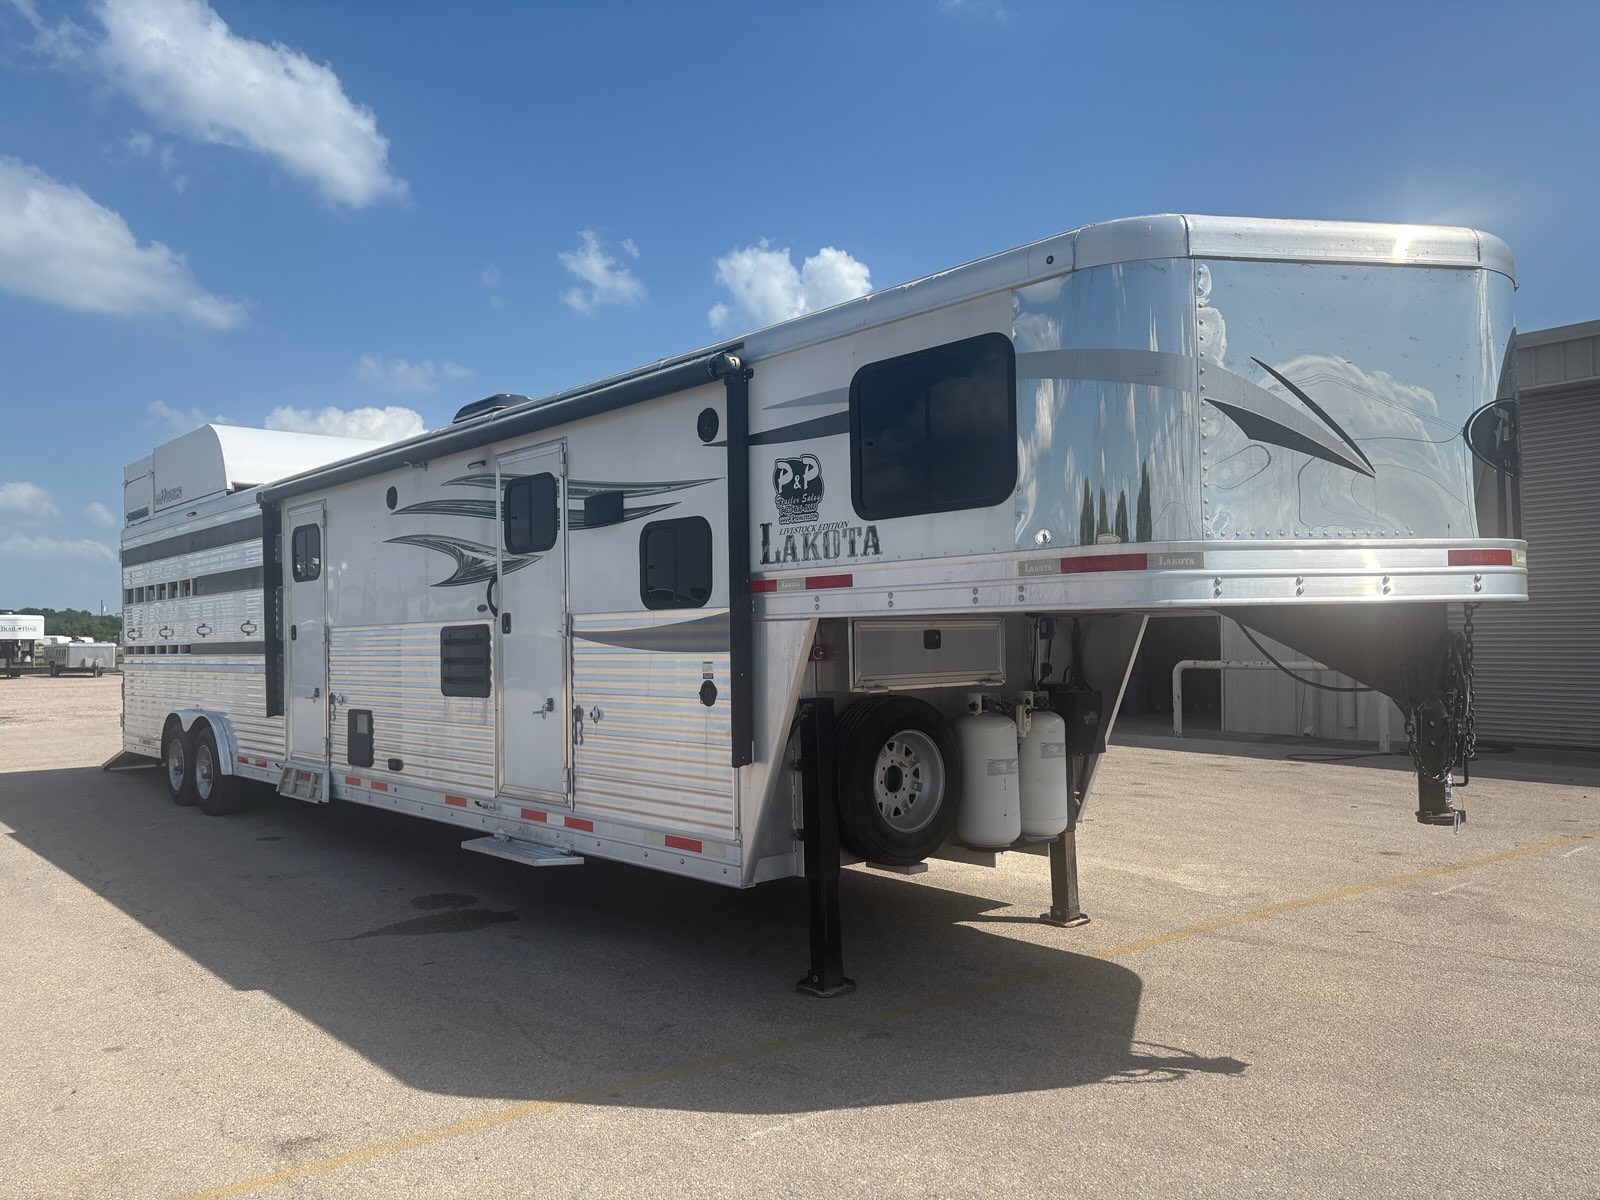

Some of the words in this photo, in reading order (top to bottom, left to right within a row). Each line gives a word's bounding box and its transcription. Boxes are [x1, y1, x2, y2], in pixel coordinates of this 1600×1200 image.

[802, 492, 821, 503] Sales
[779, 525, 817, 536] LIVESTOCK
[818, 521, 849, 531] EDITION
[759, 522, 884, 565] LAKOTA
